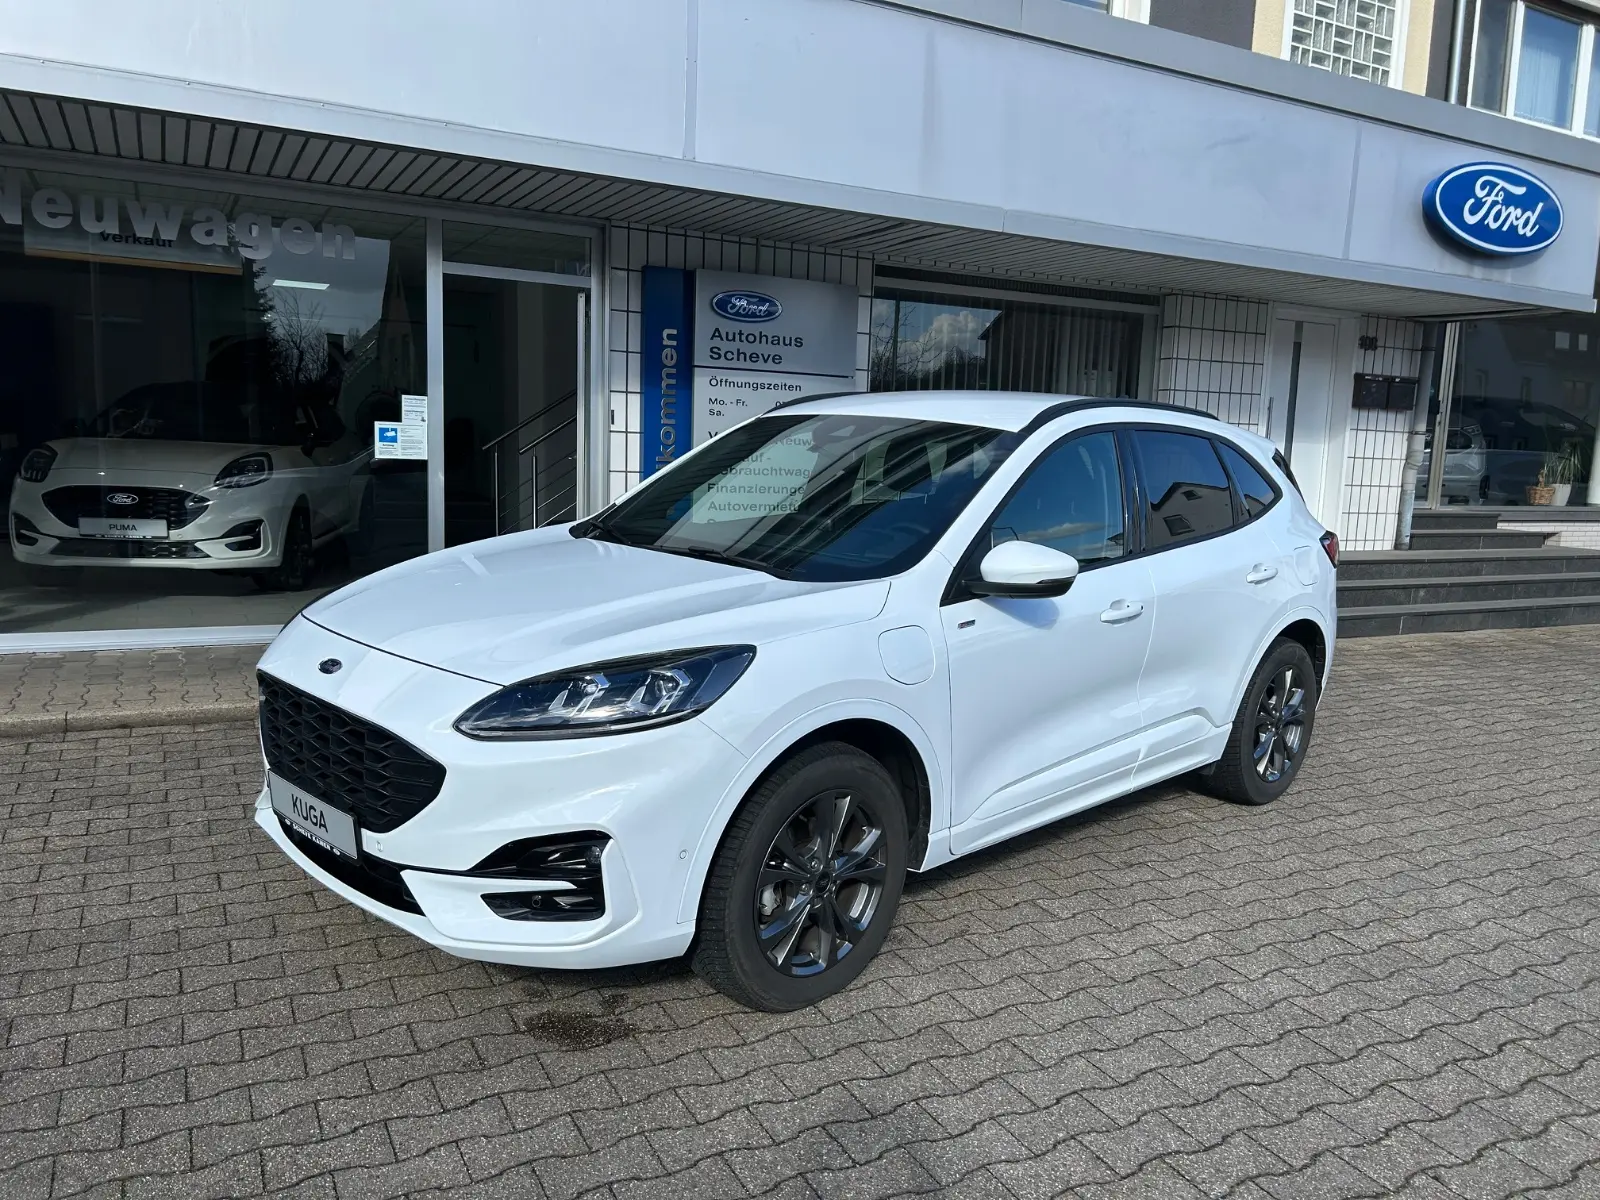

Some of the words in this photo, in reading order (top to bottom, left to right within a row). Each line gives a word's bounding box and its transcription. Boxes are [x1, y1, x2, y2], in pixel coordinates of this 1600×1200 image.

[1463, 175, 1544, 238] Ford
[727, 295, 770, 317] Ford
[709, 327, 804, 348] Autohaus
[709, 346, 783, 365] Scheve
[708, 375, 802, 392] Öffnungszeiten
[708, 397, 728, 406] Mo.
[736, 398, 748, 407] Fr.
[708, 408, 725, 417] Sa.
[109, 523, 137, 532] PUMA
[291, 793, 329, 834] KUGA
